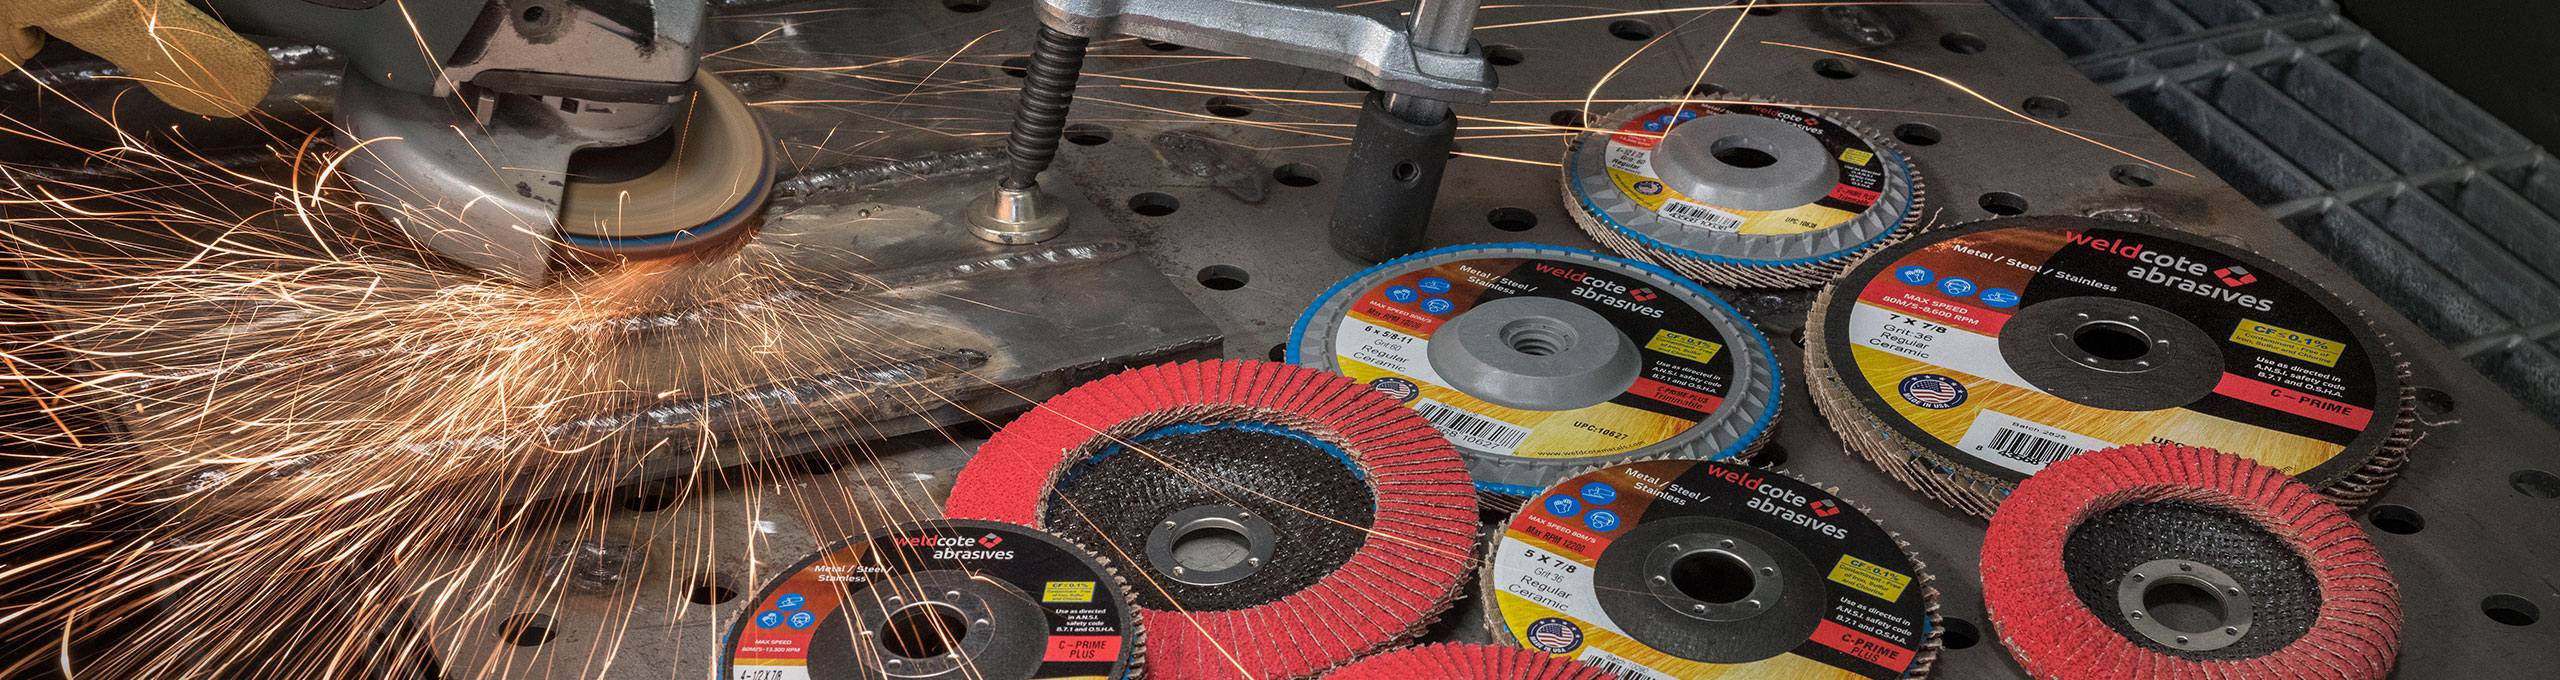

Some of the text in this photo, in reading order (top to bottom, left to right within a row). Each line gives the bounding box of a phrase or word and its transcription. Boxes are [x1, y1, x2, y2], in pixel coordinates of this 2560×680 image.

[1752, 105, 1802, 122] weldcote
[1612, 158, 1640, 170] Regular
[2065, 230, 2208, 276] weldcote
[1459, 264, 1527, 289] Metal Steel
[1536, 262, 1627, 294] weldcote
[1953, 244, 2118, 293] Metal Steel Stainless
[1467, 276, 1516, 295] Stainless
[2127, 266, 2274, 312] abrasives
[1370, 300, 1385, 308] MAX
[1386, 305, 1409, 316] SPEED
[1571, 286, 1664, 318] abrasives
[1904, 293, 1968, 314] MAX SPEED
[1367, 307, 1380, 317] Max
[1383, 311, 1400, 323] RPM
[1953, 315, 1980, 325] RPM
[1382, 331, 1413, 344] 5/8-11
[1922, 322, 1947, 334] 7/8
[1869, 338, 1930, 359] Ceramic
[1880, 332, 1930, 350] Regular
[2244, 332, 2295, 349] Contaminant
[2300, 347, 2319, 356] Free
[1353, 352, 1407, 373] Ceramic
[1361, 345, 1409, 364] Regular
[2256, 341, 2279, 350] Sulfur
[2298, 351, 2332, 364] Chlorine
[1656, 360, 1671, 368] Use
[1682, 366, 1713, 378] directed
[2254, 363, 2346, 391] A.N.S.I. safety code
[2256, 356, 2275, 366] Use
[2290, 365, 2330, 380] directed
[2332, 375, 2341, 383] in
[1679, 373, 1703, 383] safety
[1703, 380, 1722, 388] code
[2257, 372, 2343, 398] B.7.1 and O.S.H.A.
[1654, 391, 1703, 409] Trimmable
[2299, 396, 2353, 416] PRIME
[2012, 421, 2040, 433] Batch
[1463, 435, 1500, 450] 10627
[1537, 440, 1646, 456] www.weldcotemetals.com
[1625, 467, 1700, 500] Metal Steel
[1633, 482, 1687, 506] Stainless
[1707, 463, 1807, 507] weldcote
[1528, 514, 1596, 544] MAX SPEED 80M/S
[1747, 497, 1848, 540] abrasives
[895, 534, 975, 547] weldcote
[1525, 525, 1586, 553] Max RPM 12200
[933, 548, 1014, 560] abrasives
[1523, 549, 1534, 558] 5
[1556, 559, 1577, 574] 7/8
[814, 565, 884, 574] Metal Steel
[818, 574, 867, 583] Stainless
[1551, 574, 1565, 584] 36
[1839, 564, 1901, 590] Contaminant Free
[1520, 574, 1572, 600] Regular
[1856, 583, 1884, 596] Chlorine
[1508, 583, 1569, 613] Ceramic
[1836, 605, 1912, 636] A.N.S.I. safety code
[1840, 596, 1856, 606] Use
[1868, 606, 1902, 623] directed
[1902, 618, 1911, 626] in
[1836, 614, 1907, 645] B.7.1 and O.S.H.A.
[1069, 649, 1096, 659] PLUS
[1075, 640, 1107, 650] PRIME
[1841, 633, 1900, 660] C-PRIME
[1851, 646, 1880, 663] PLUS
